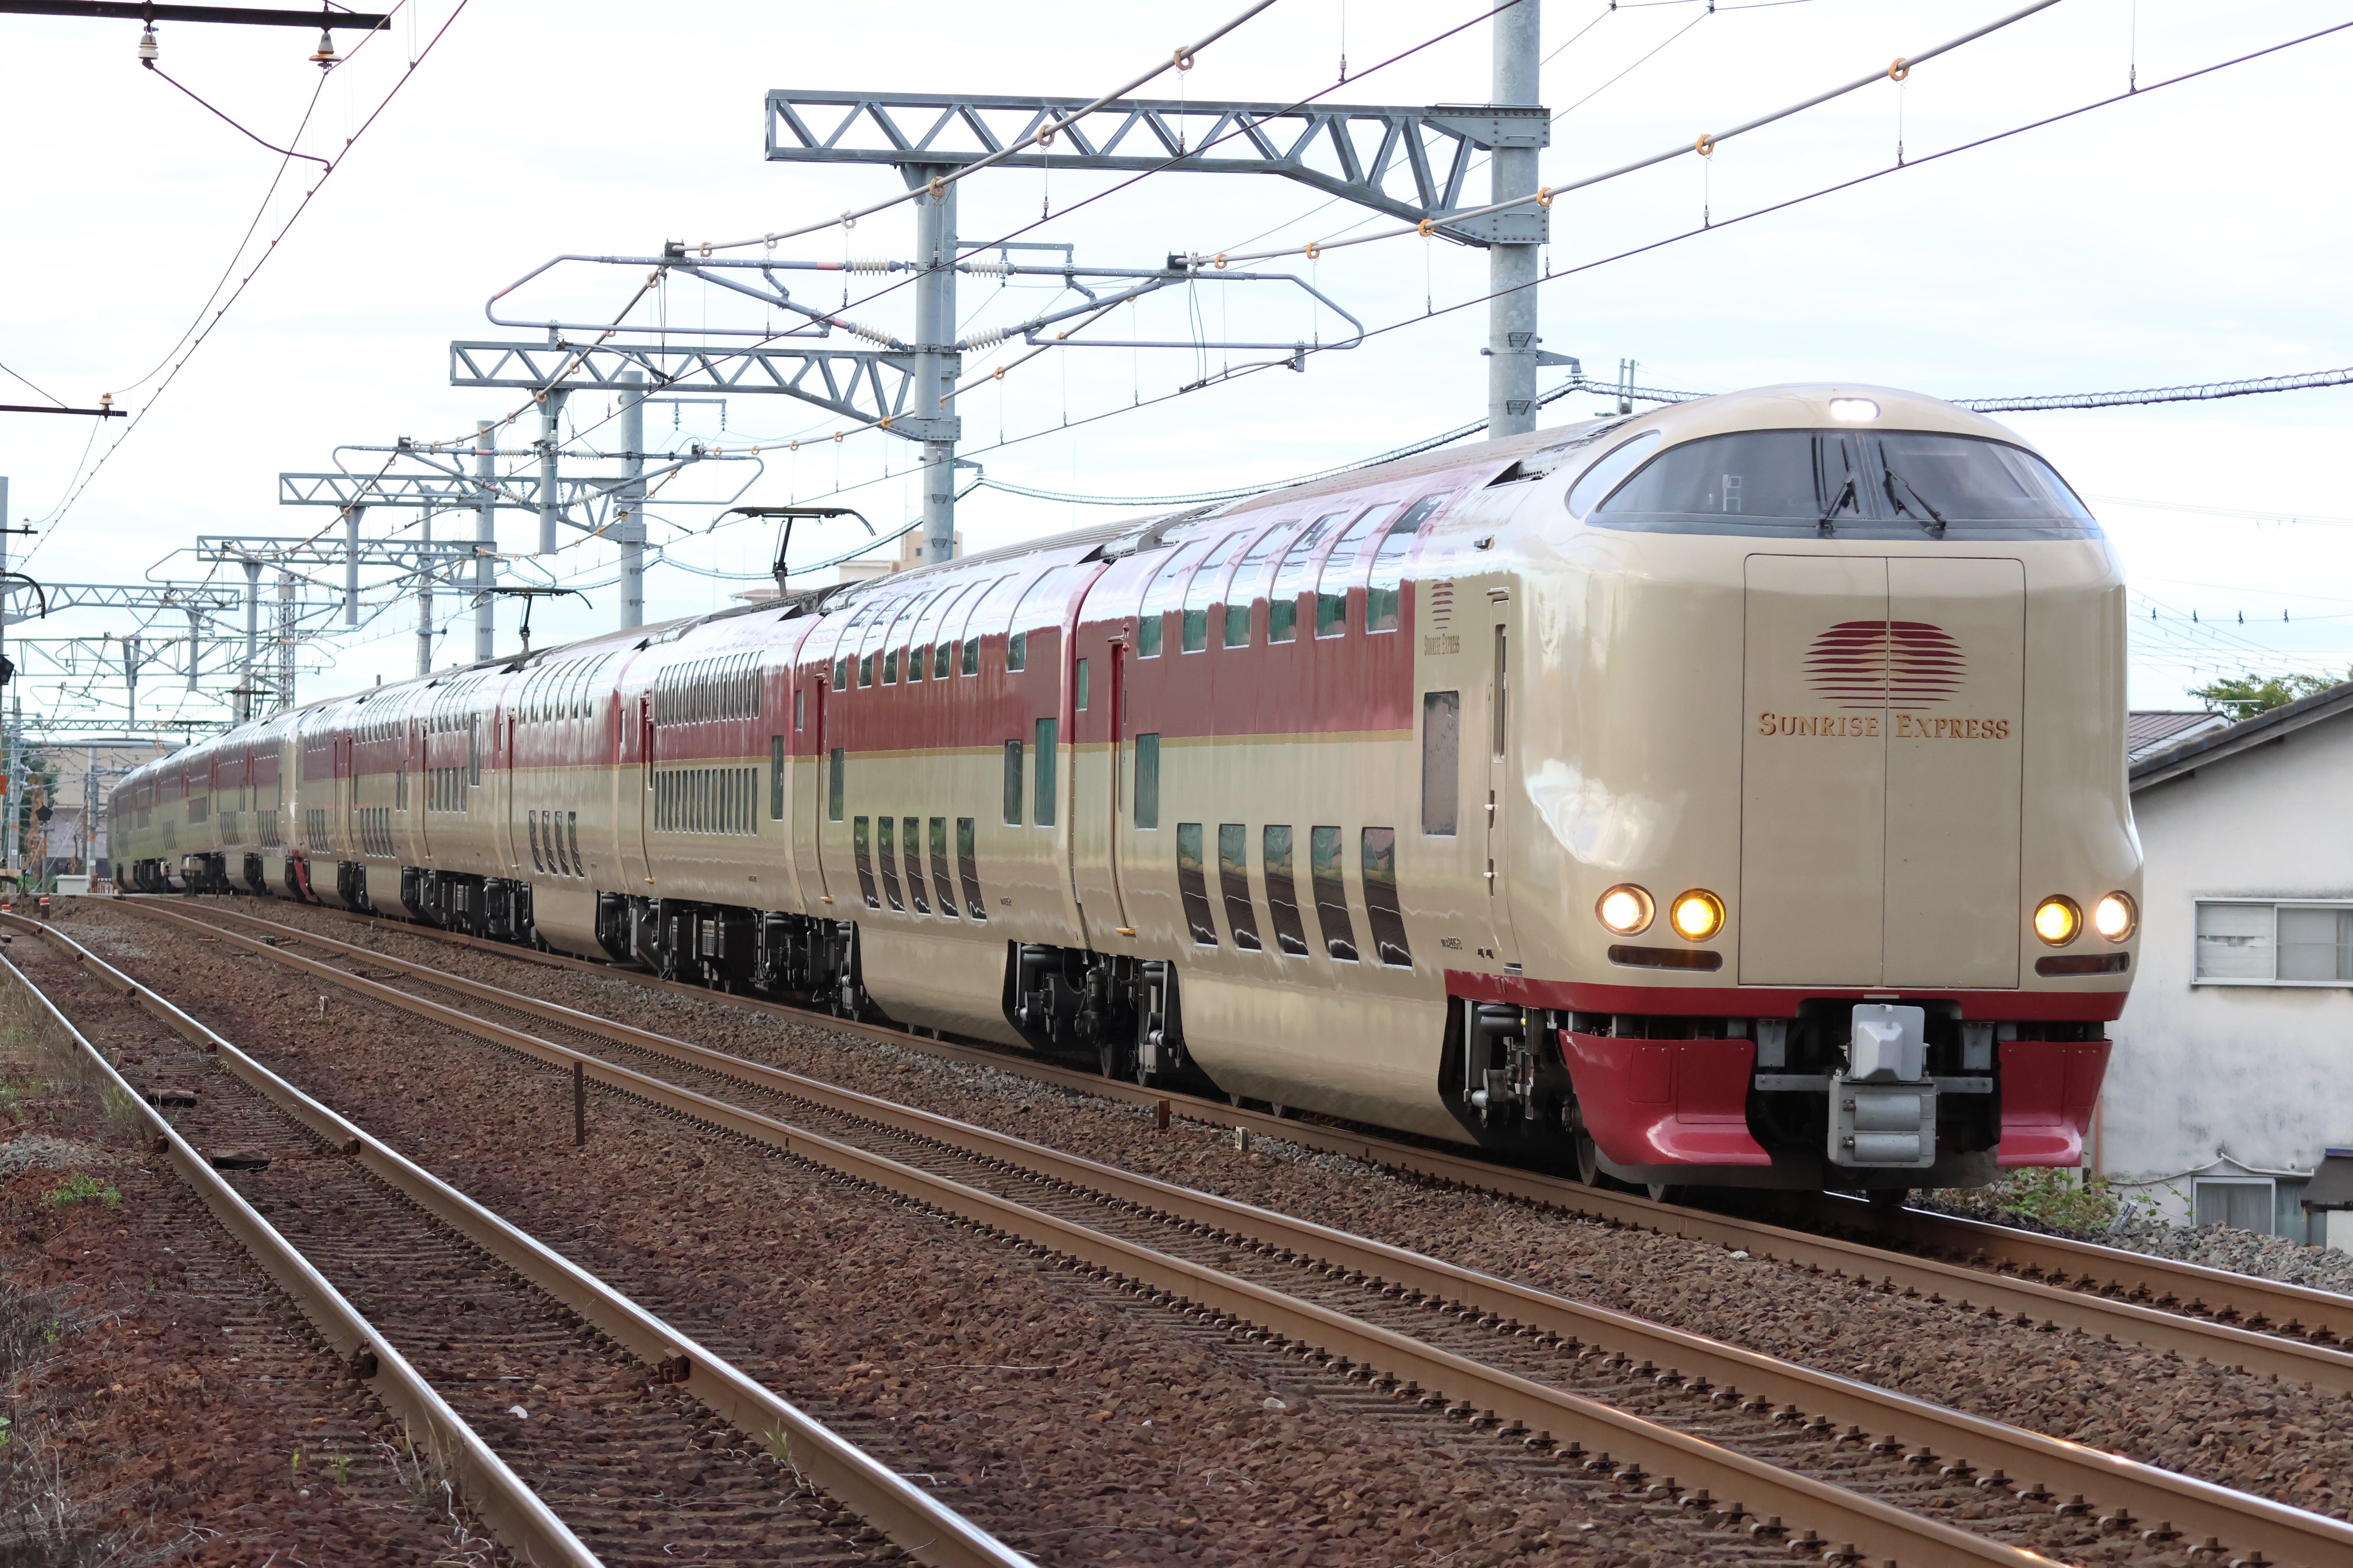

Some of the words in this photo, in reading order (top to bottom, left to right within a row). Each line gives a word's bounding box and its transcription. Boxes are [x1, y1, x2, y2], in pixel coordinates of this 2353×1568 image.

[1424, 635, 1441, 656] SUNRISE
[1442, 633, 1460, 654] EXPRESS
[1757, 710, 1880, 737] SUNRISE
[1896, 713, 2010, 739] EXPRESS
